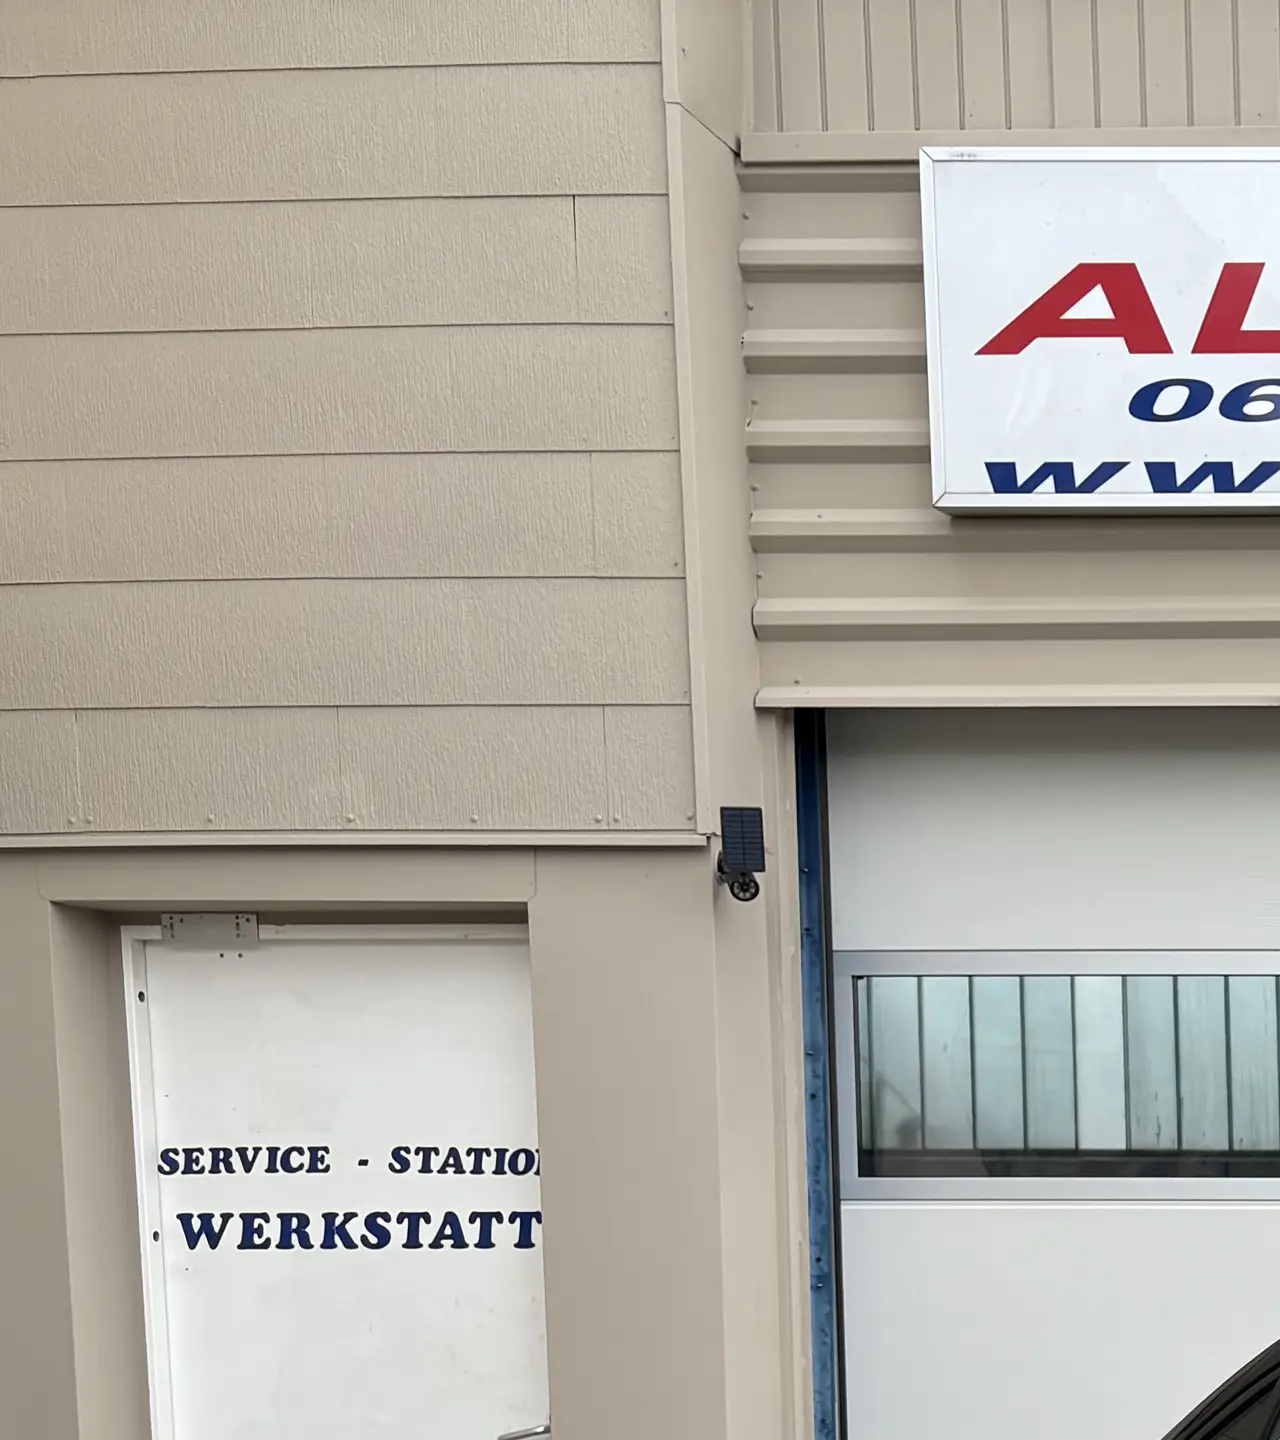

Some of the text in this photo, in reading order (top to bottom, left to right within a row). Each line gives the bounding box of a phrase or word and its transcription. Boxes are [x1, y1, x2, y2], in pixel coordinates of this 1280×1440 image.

[157, 1145, 331, 1176] SERVICE
[388, 1146, 540, 1176] STATIO
[176, 1211, 543, 1251] WERKSTATT
